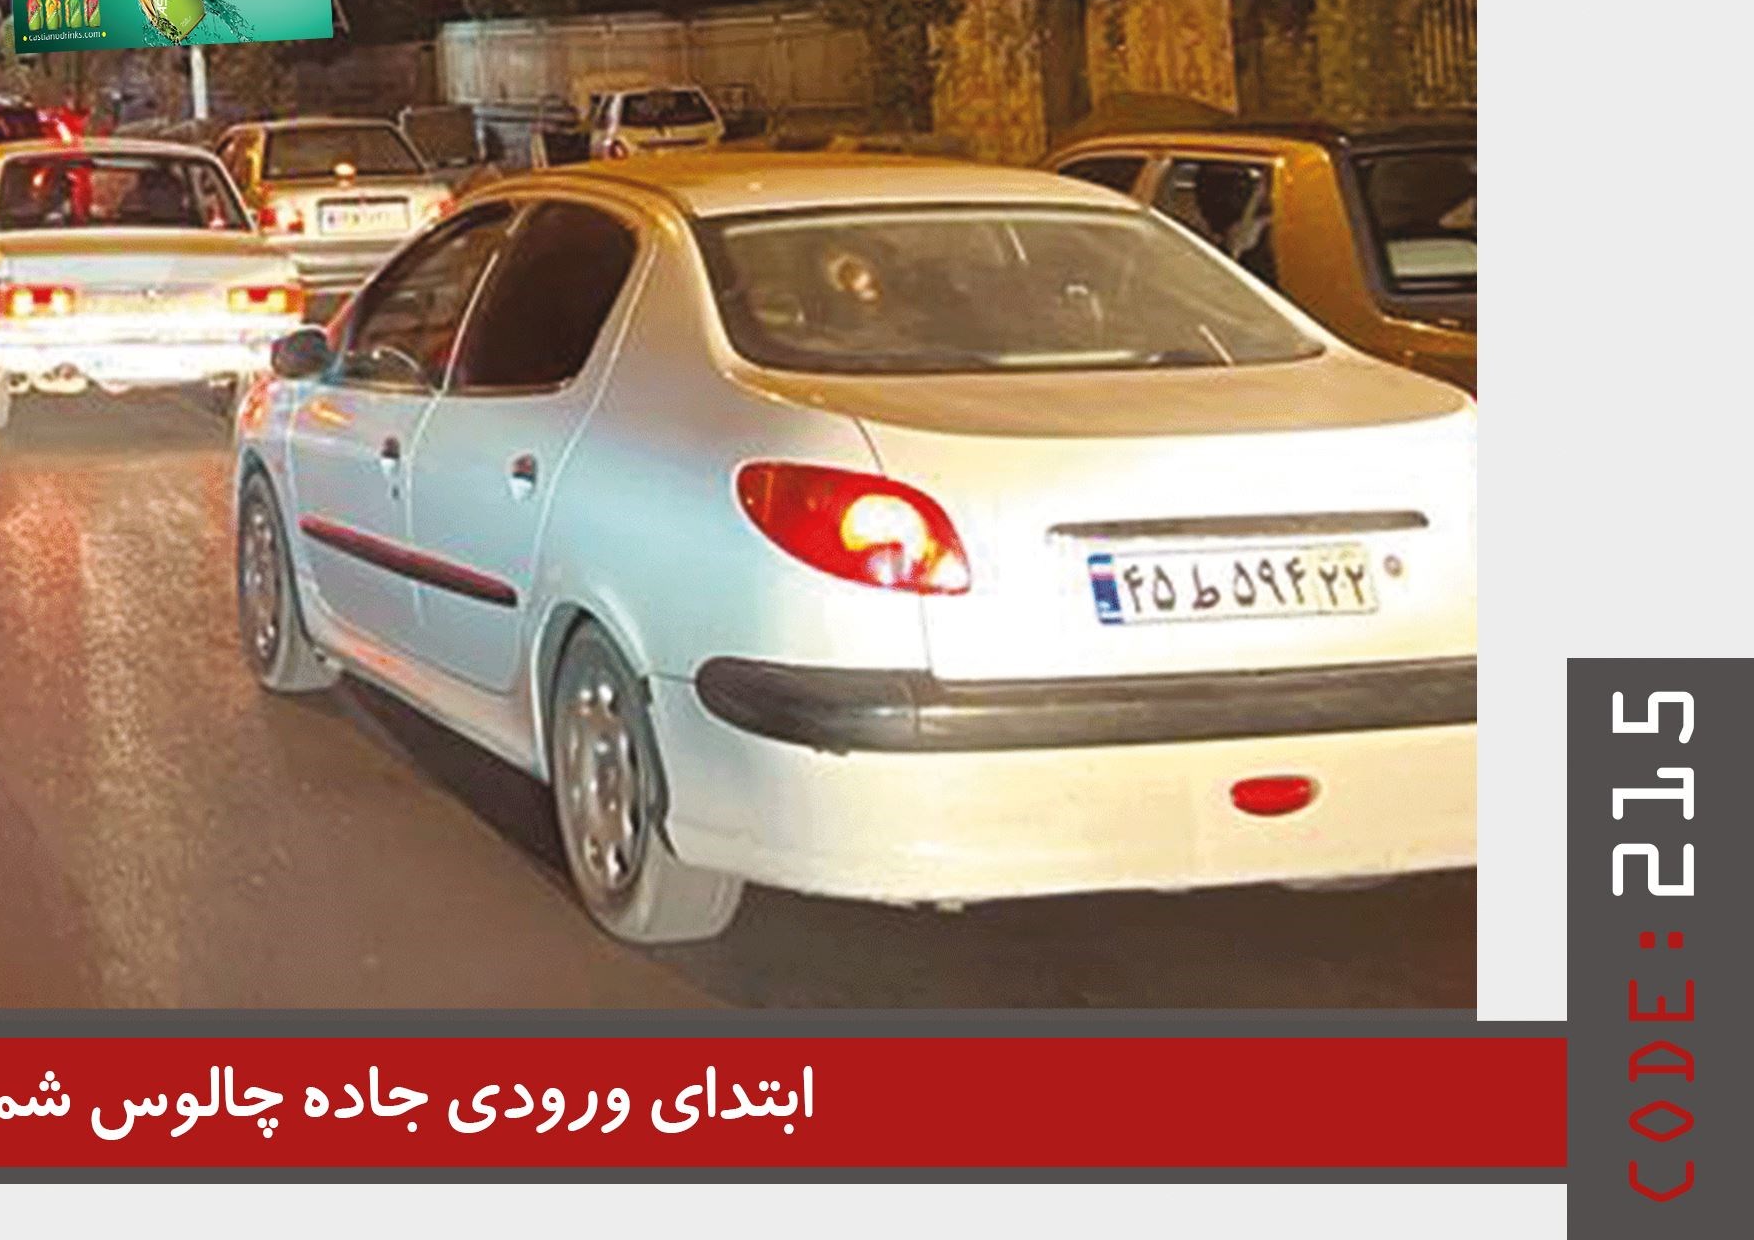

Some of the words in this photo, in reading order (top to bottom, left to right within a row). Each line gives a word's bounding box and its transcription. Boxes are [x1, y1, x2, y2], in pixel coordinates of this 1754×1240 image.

[1123, 564, 1177, 613] ۴۵
[1191, 564, 1221, 610] ط
[1233, 557, 1307, 606] ۵۹۴
[1318, 563, 1365, 606] ۲۲
